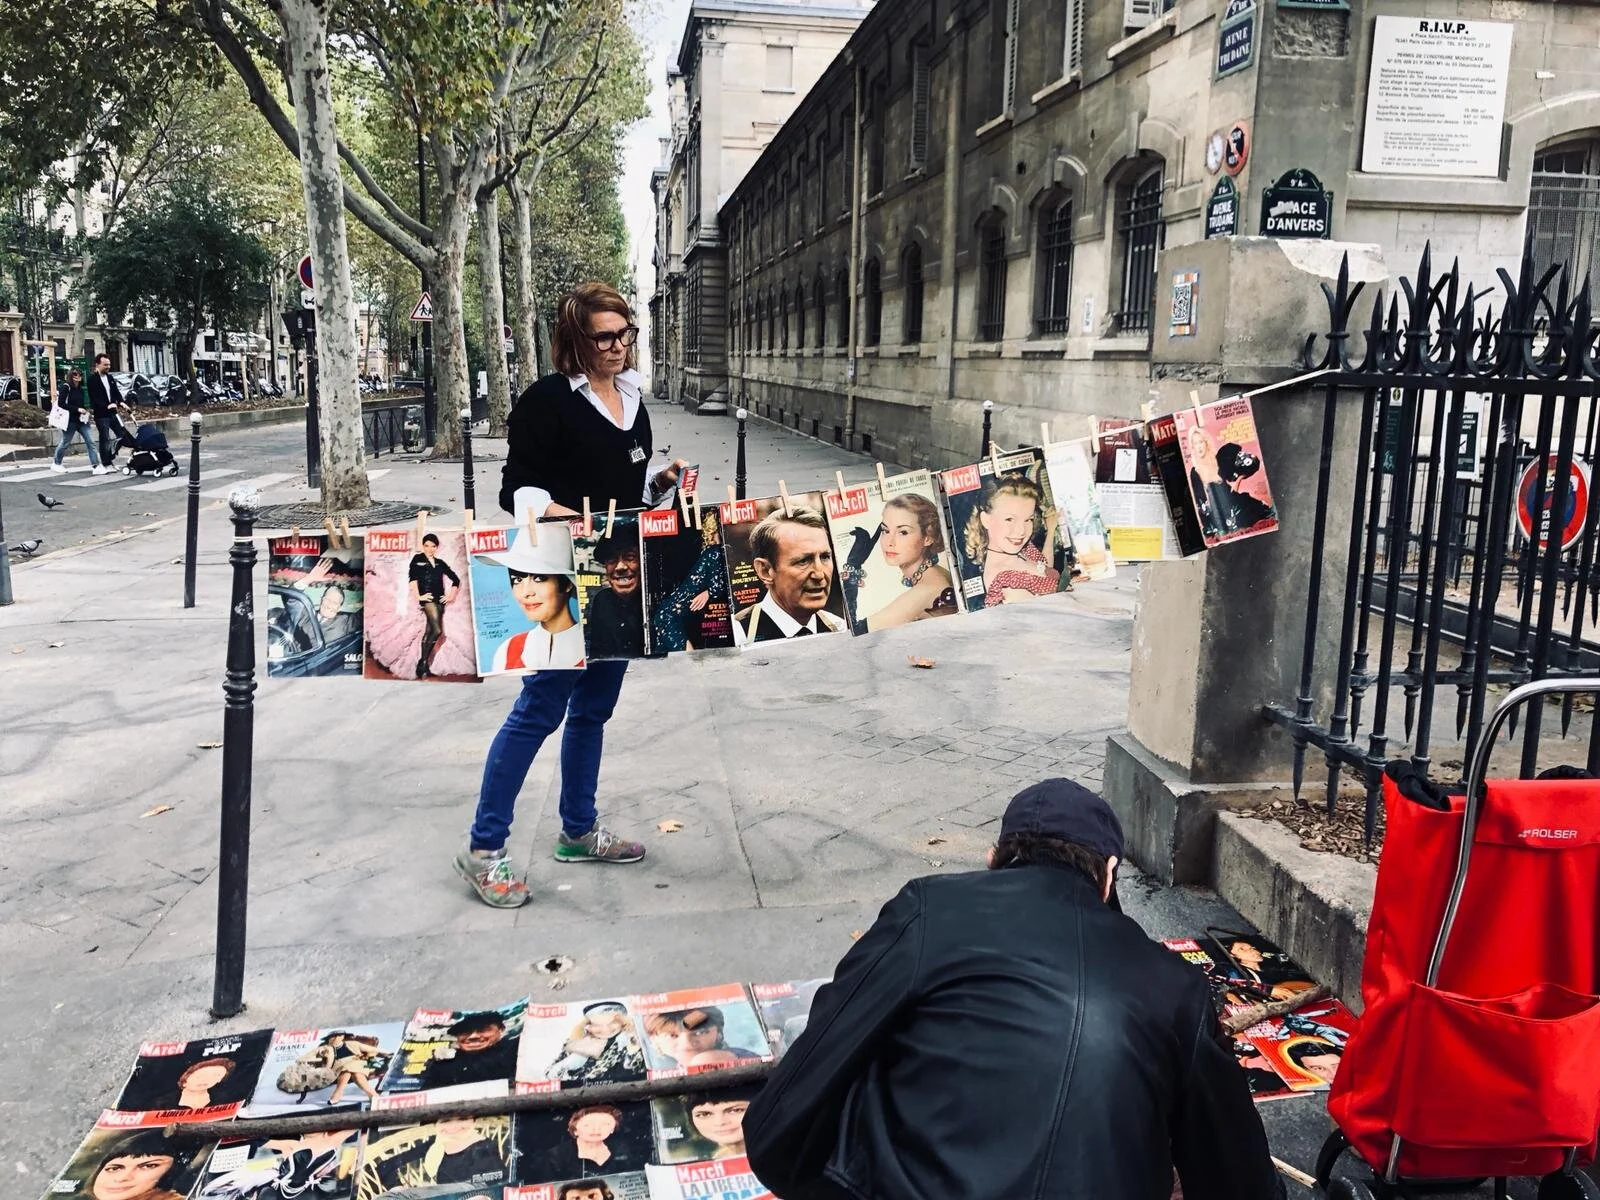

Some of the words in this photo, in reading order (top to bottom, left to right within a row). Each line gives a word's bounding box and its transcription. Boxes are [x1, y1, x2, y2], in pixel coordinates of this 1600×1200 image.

[1419, 21, 1469, 34] R.I.V.P.
[1266, 217, 1324, 231] D'ANVERS
[945, 466, 978, 492] MATCH
[722, 503, 755, 523] MTCH
[642, 514, 676, 534] MATCH
[275, 538, 319, 550] MATCH
[371, 534, 407, 551] MATCH
[470, 530, 508, 553] MATCH
[1531, 828, 1578, 839] ROLSER
[414, 1011, 451, 1025] MATCH
[529, 1004, 566, 1017] MATCH
[140, 1041, 188, 1056] MATCH
[202, 1043, 242, 1057] PIAF
[516, 1079, 560, 1095] MATCH
[101, 1110, 144, 1126] MATCH
[678, 1162, 726, 1183] MATCH
[508, 1186, 552, 1200] MATCH
[681, 1183, 701, 1198] LA
